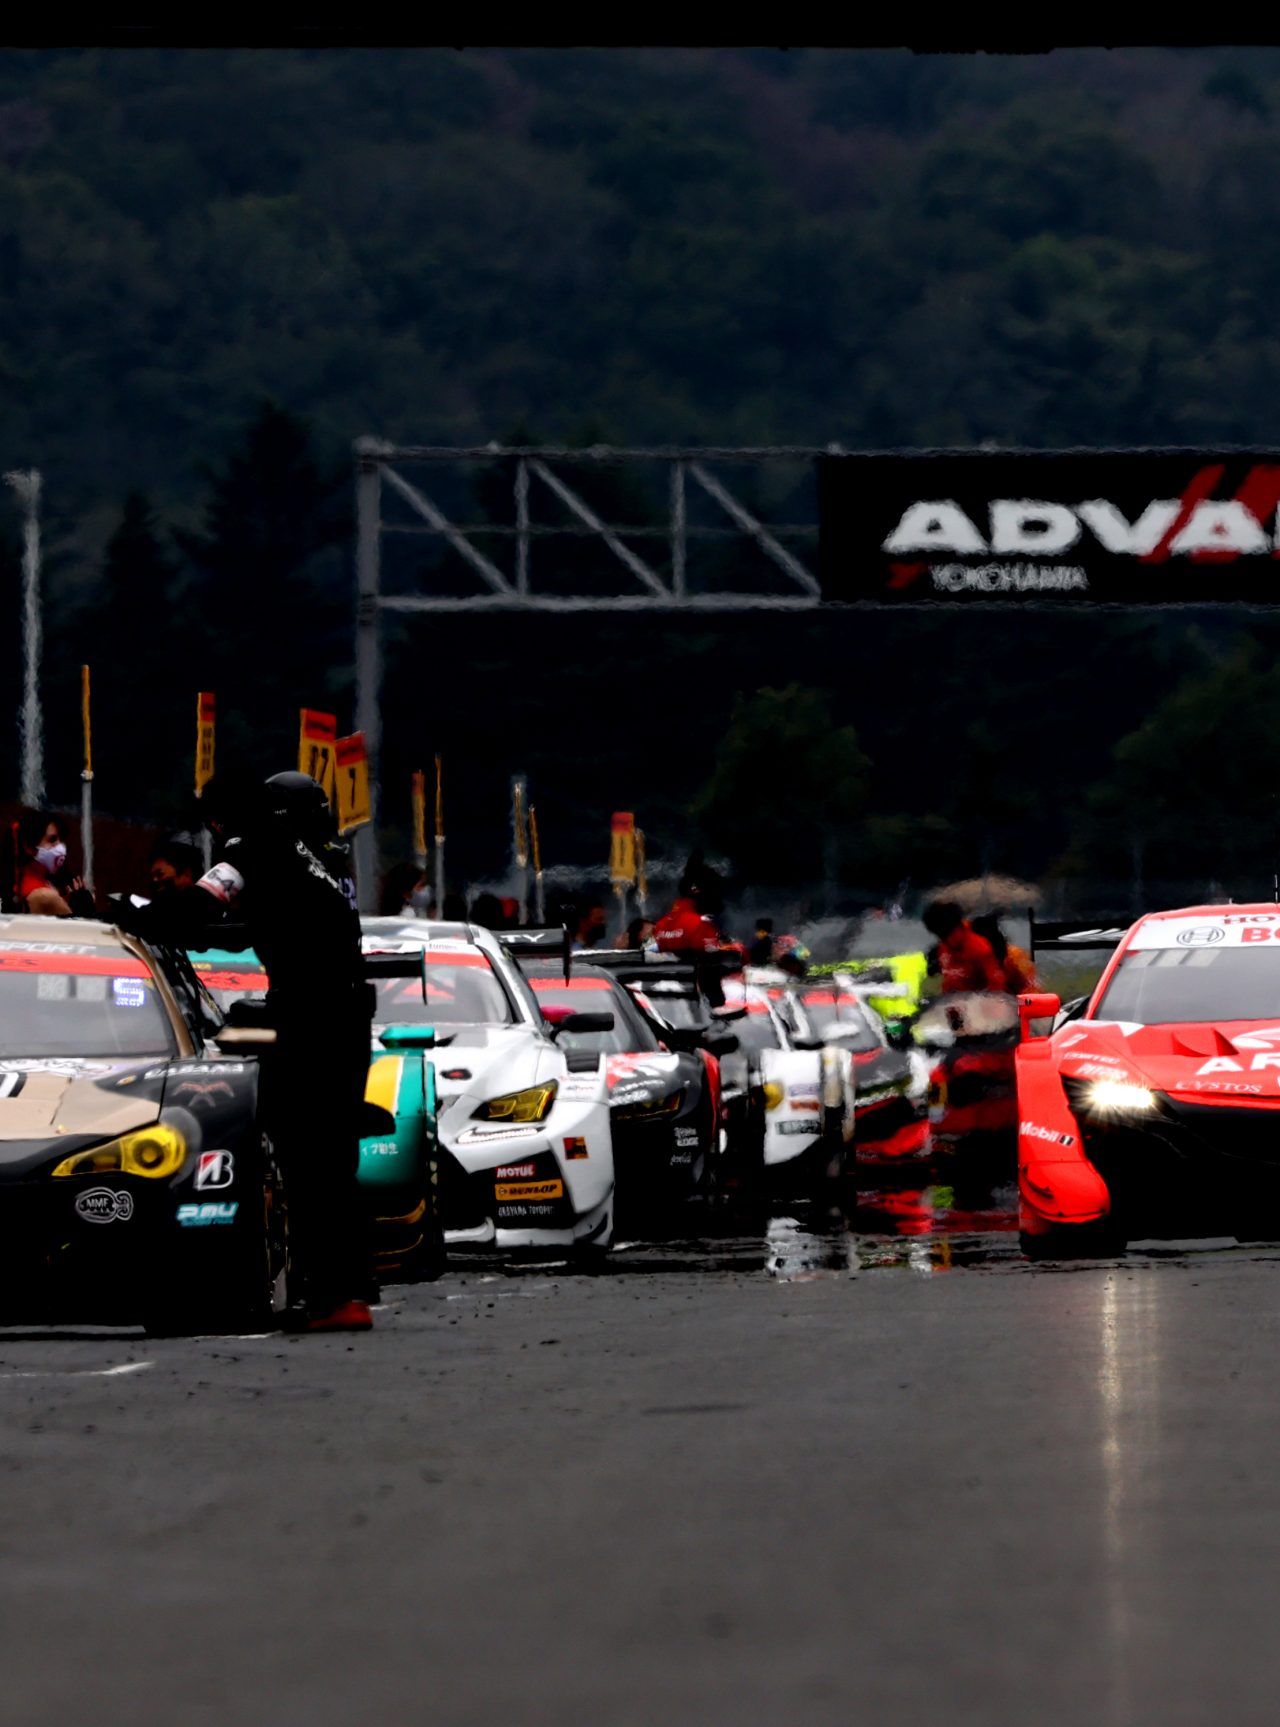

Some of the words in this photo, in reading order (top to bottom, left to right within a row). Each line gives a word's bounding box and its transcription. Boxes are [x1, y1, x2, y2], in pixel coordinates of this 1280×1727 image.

[1175, 1081, 1264, 1094] CVSTOS
[1020, 1121, 1060, 1143] Mobil
[496, 1164, 535, 1179] MOTUL
[508, 1184, 558, 1196] DUNLOP
